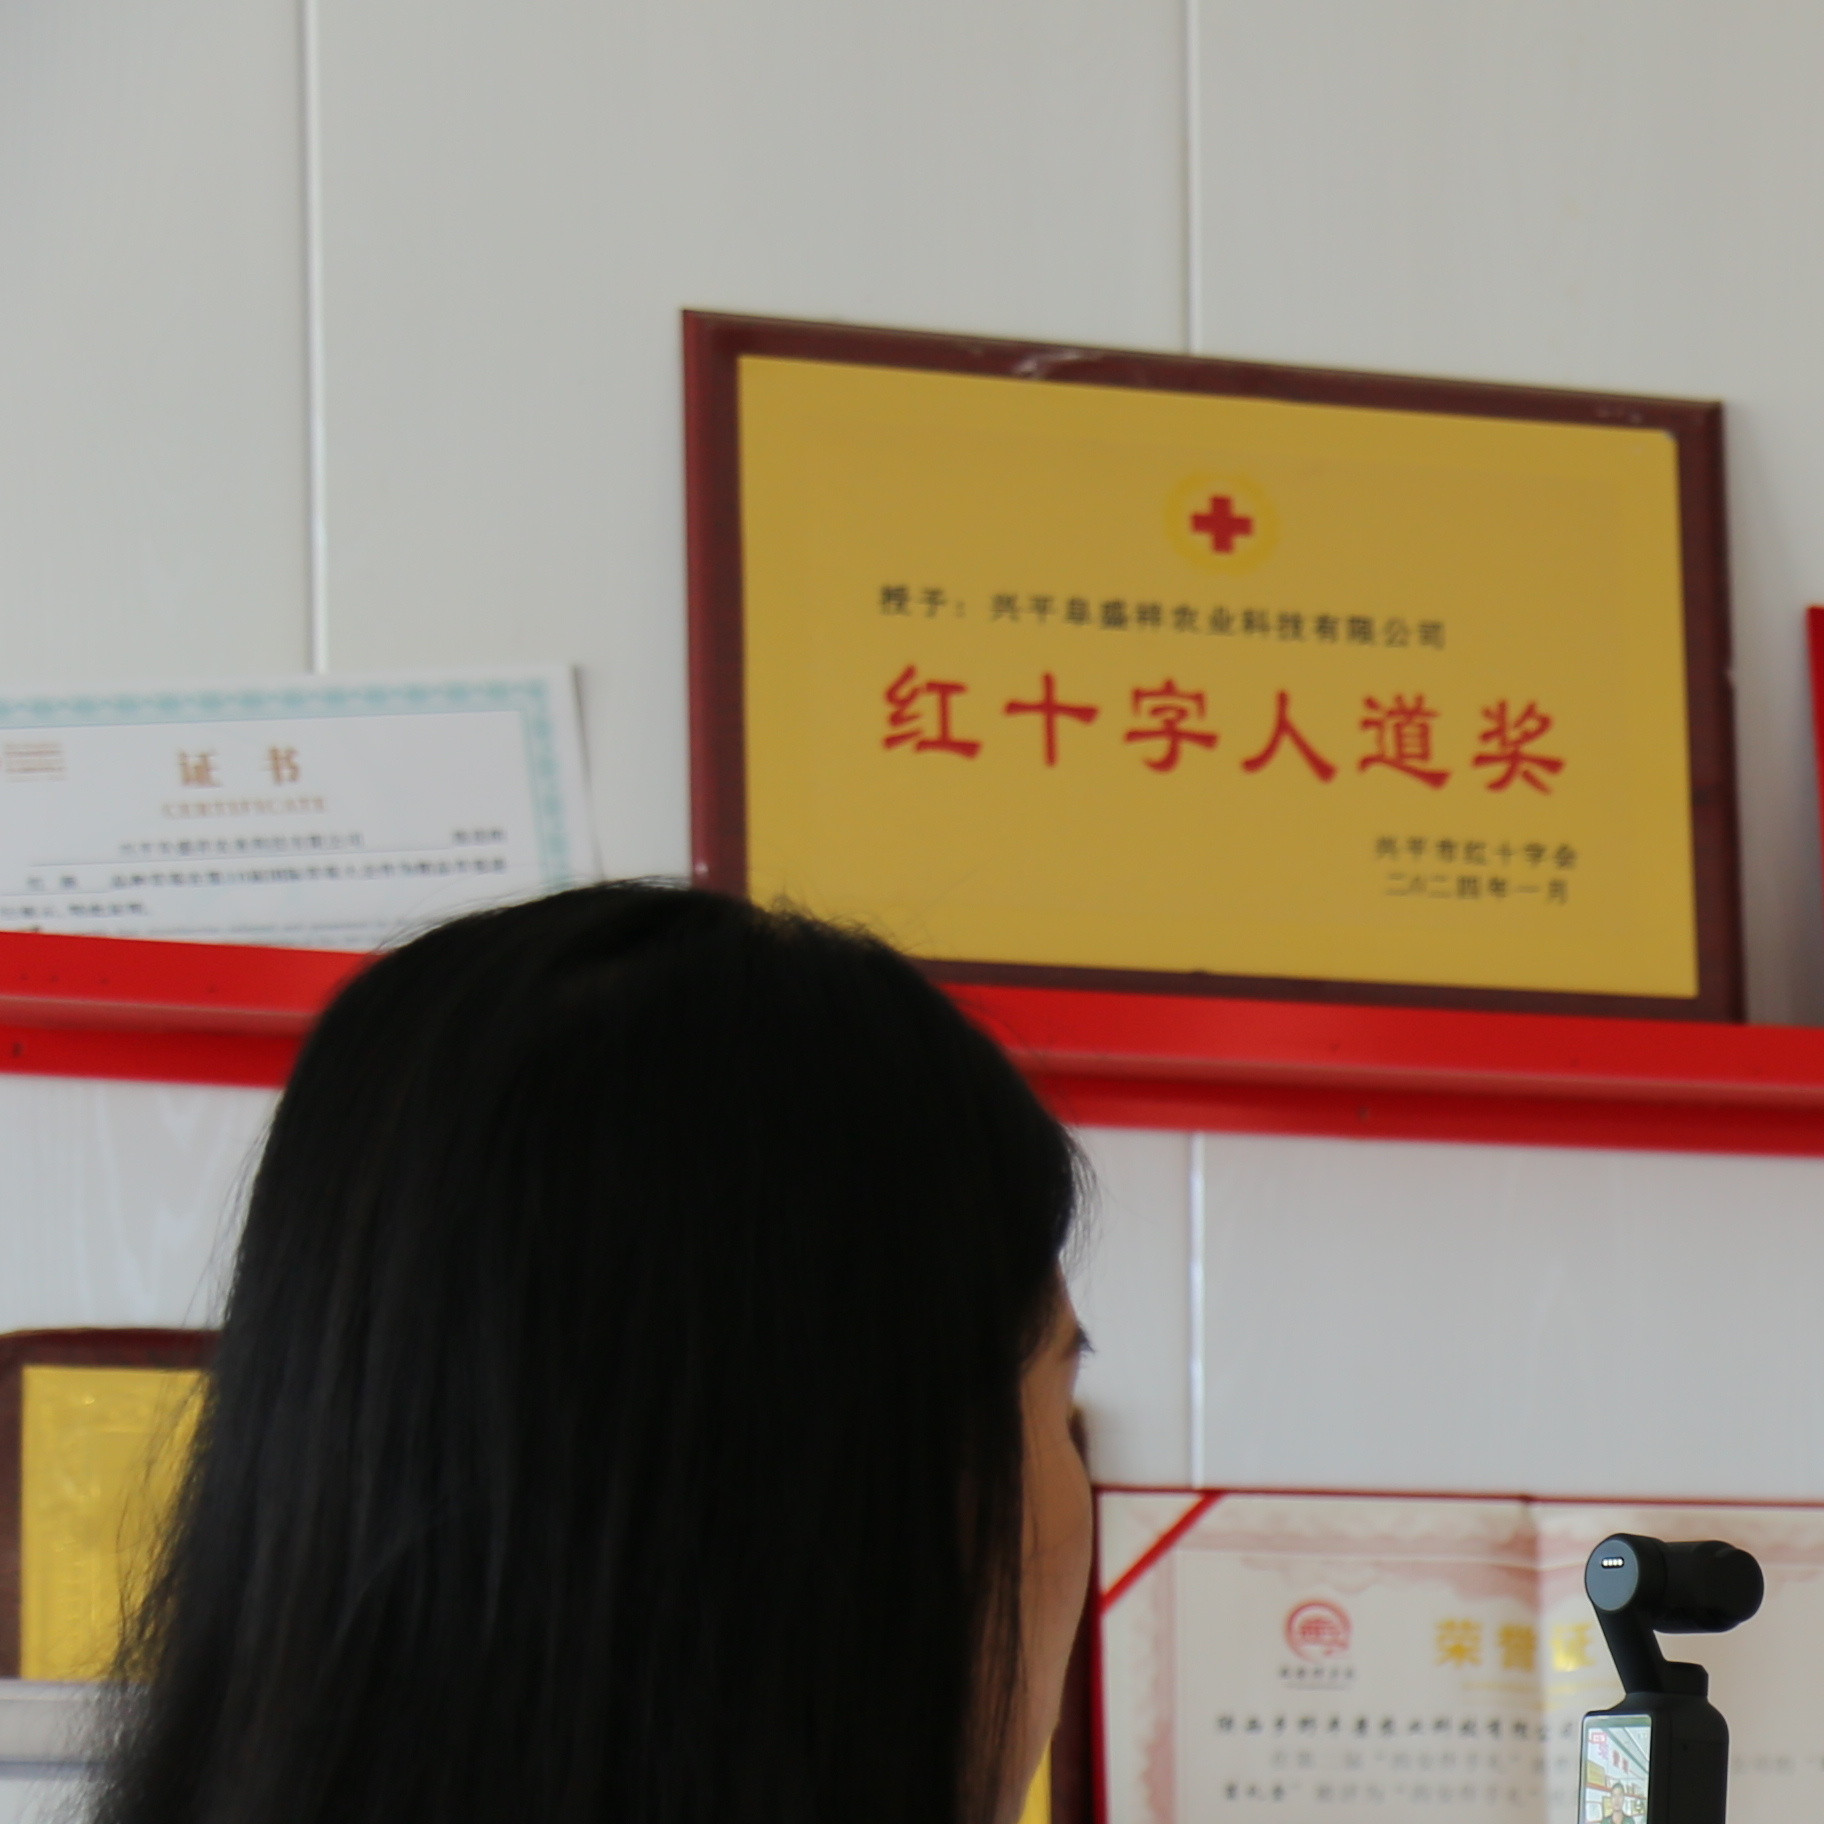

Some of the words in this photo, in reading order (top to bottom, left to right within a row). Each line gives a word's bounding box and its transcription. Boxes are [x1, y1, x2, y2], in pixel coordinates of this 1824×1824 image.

[177, 744, 302, 789] 证书
[880, 663, 1566, 796] 红十字人道奖
